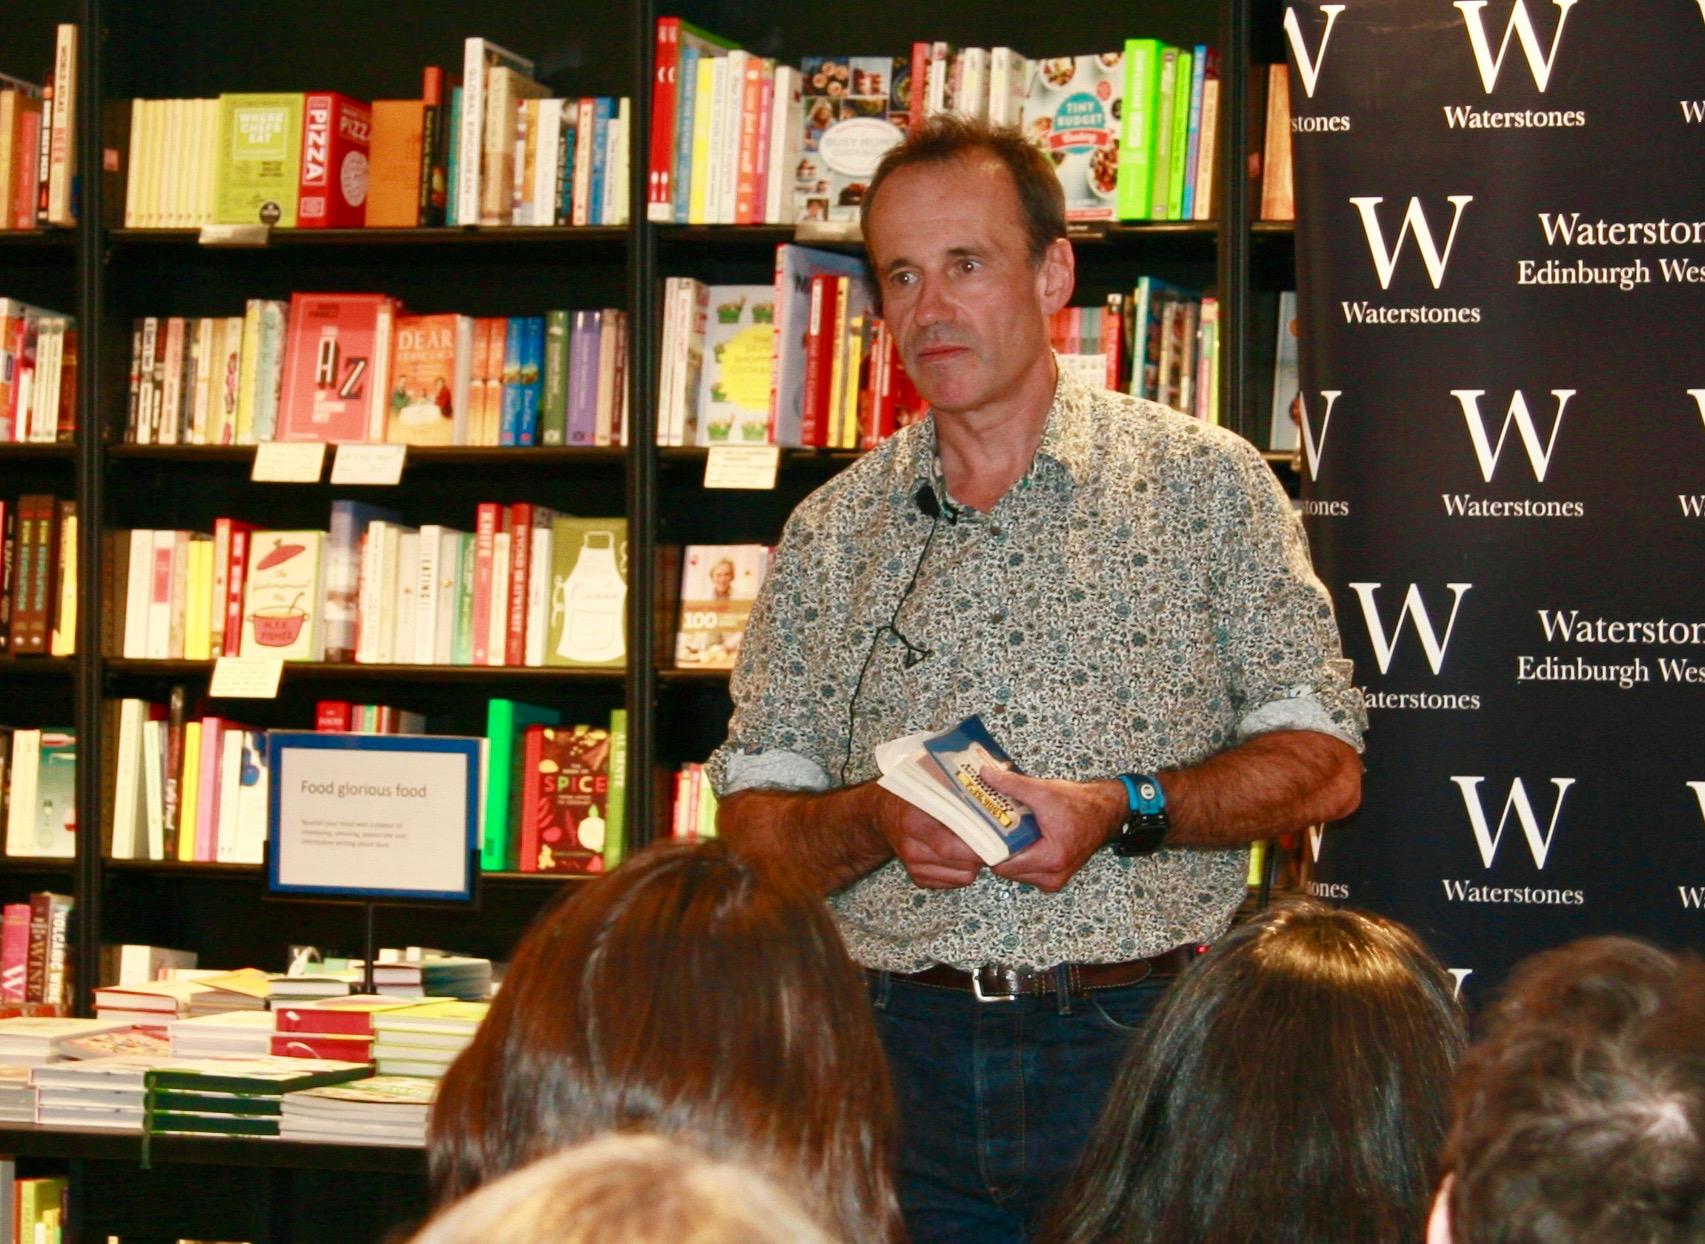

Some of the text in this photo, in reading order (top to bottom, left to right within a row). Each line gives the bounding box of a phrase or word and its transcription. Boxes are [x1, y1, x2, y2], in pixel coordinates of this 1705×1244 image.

[1454, 0, 1578, 94] W
[1444, 106, 1586, 129] Waterstones
[306, 109, 328, 181] PIZZA
[1349, 195, 1473, 290] W
[1517, 260, 1651, 291] Edinburgh
[1341, 301, 1481, 324] Waterstones
[399, 329, 454, 350] DEAR
[1450, 389, 1577, 483] W
[1442, 494, 1584, 517] Waterstones
[1678, 494, 1705, 518] W
[684, 612, 717, 628] 100
[1348, 582, 1472, 675] W
[1516, 656, 1650, 688] Edinburgh
[1361, 686, 1481, 709] aterstones
[301, 781, 428, 798] Food glorious food
[544, 775, 607, 793] SPICE
[1450, 776, 1576, 870] W
[1442, 879, 1584, 905] Waterstones
[1678, 886, 1705, 909] W
